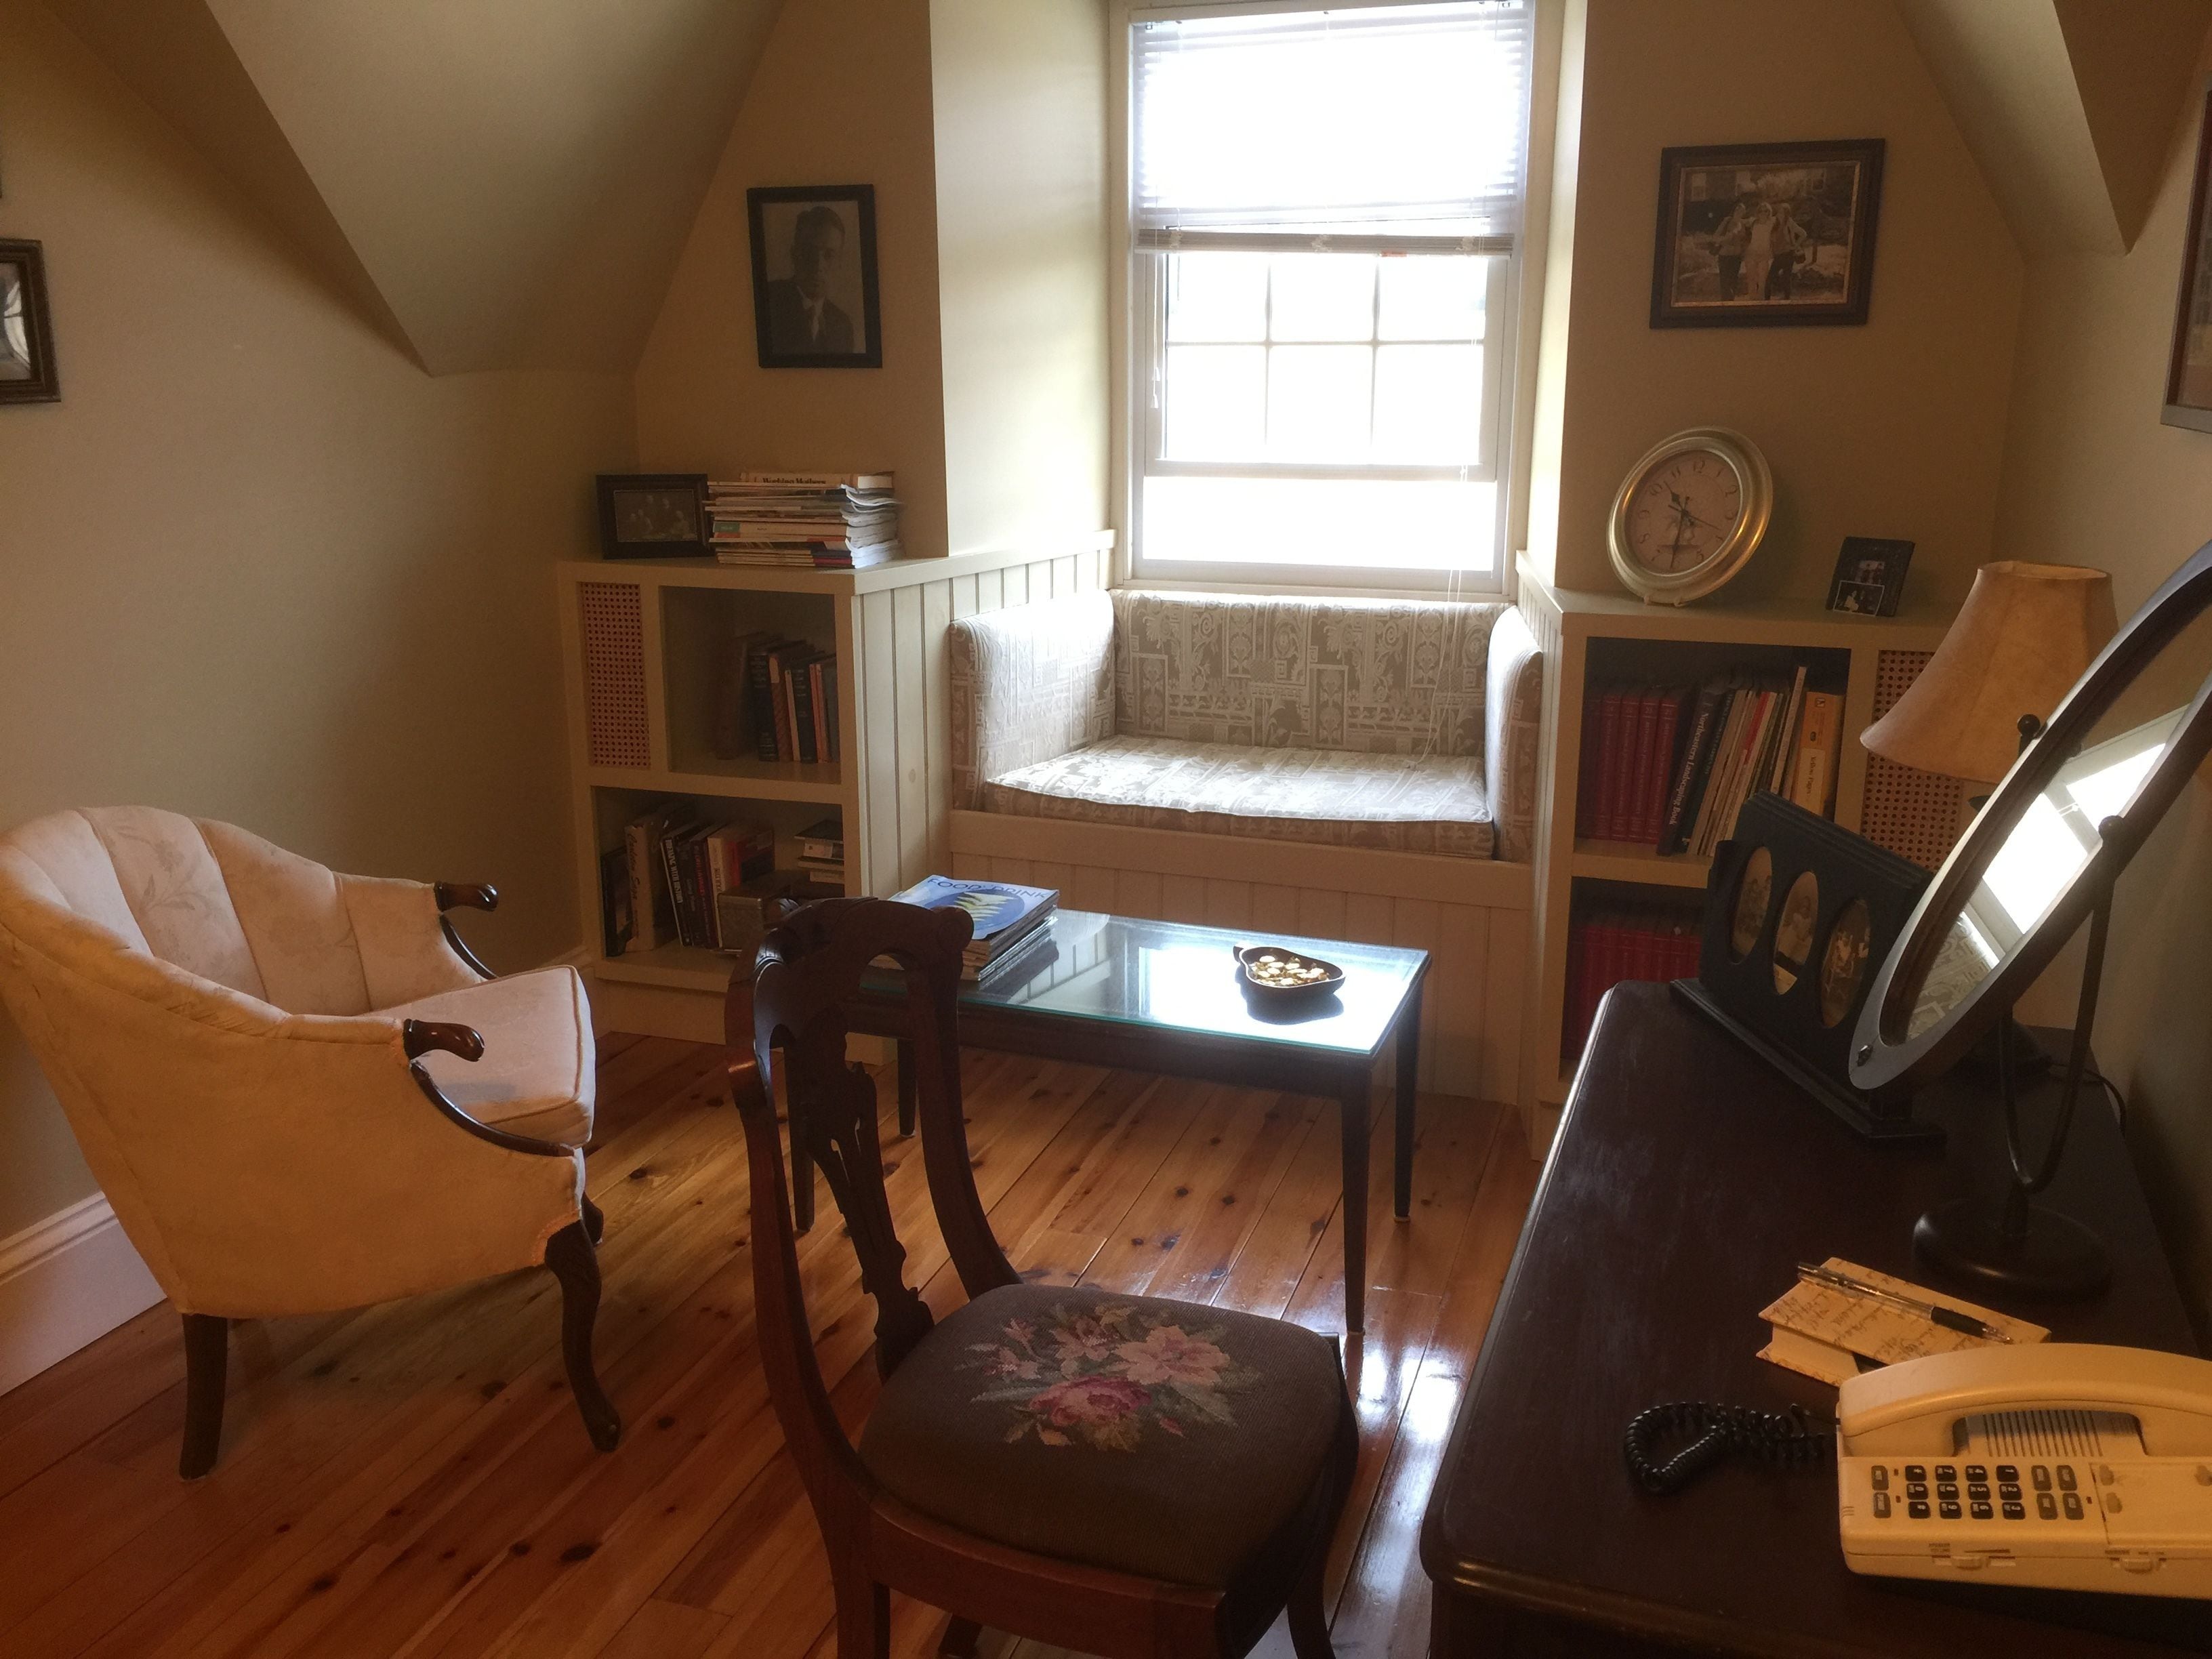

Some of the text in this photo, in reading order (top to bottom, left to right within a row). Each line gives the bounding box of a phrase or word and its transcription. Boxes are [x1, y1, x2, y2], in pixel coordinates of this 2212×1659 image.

[1671, 466, 1681, 478] 11
[1693, 460, 1706, 474] 12
[1649, 483, 1663, 496] 10
[1725, 485, 1739, 497] 2
[1669, 712, 1709, 825] Northeastern Landscaping Book
[927, 878, 982, 890] FOOD
[989, 885, 1048, 899] DRINK
